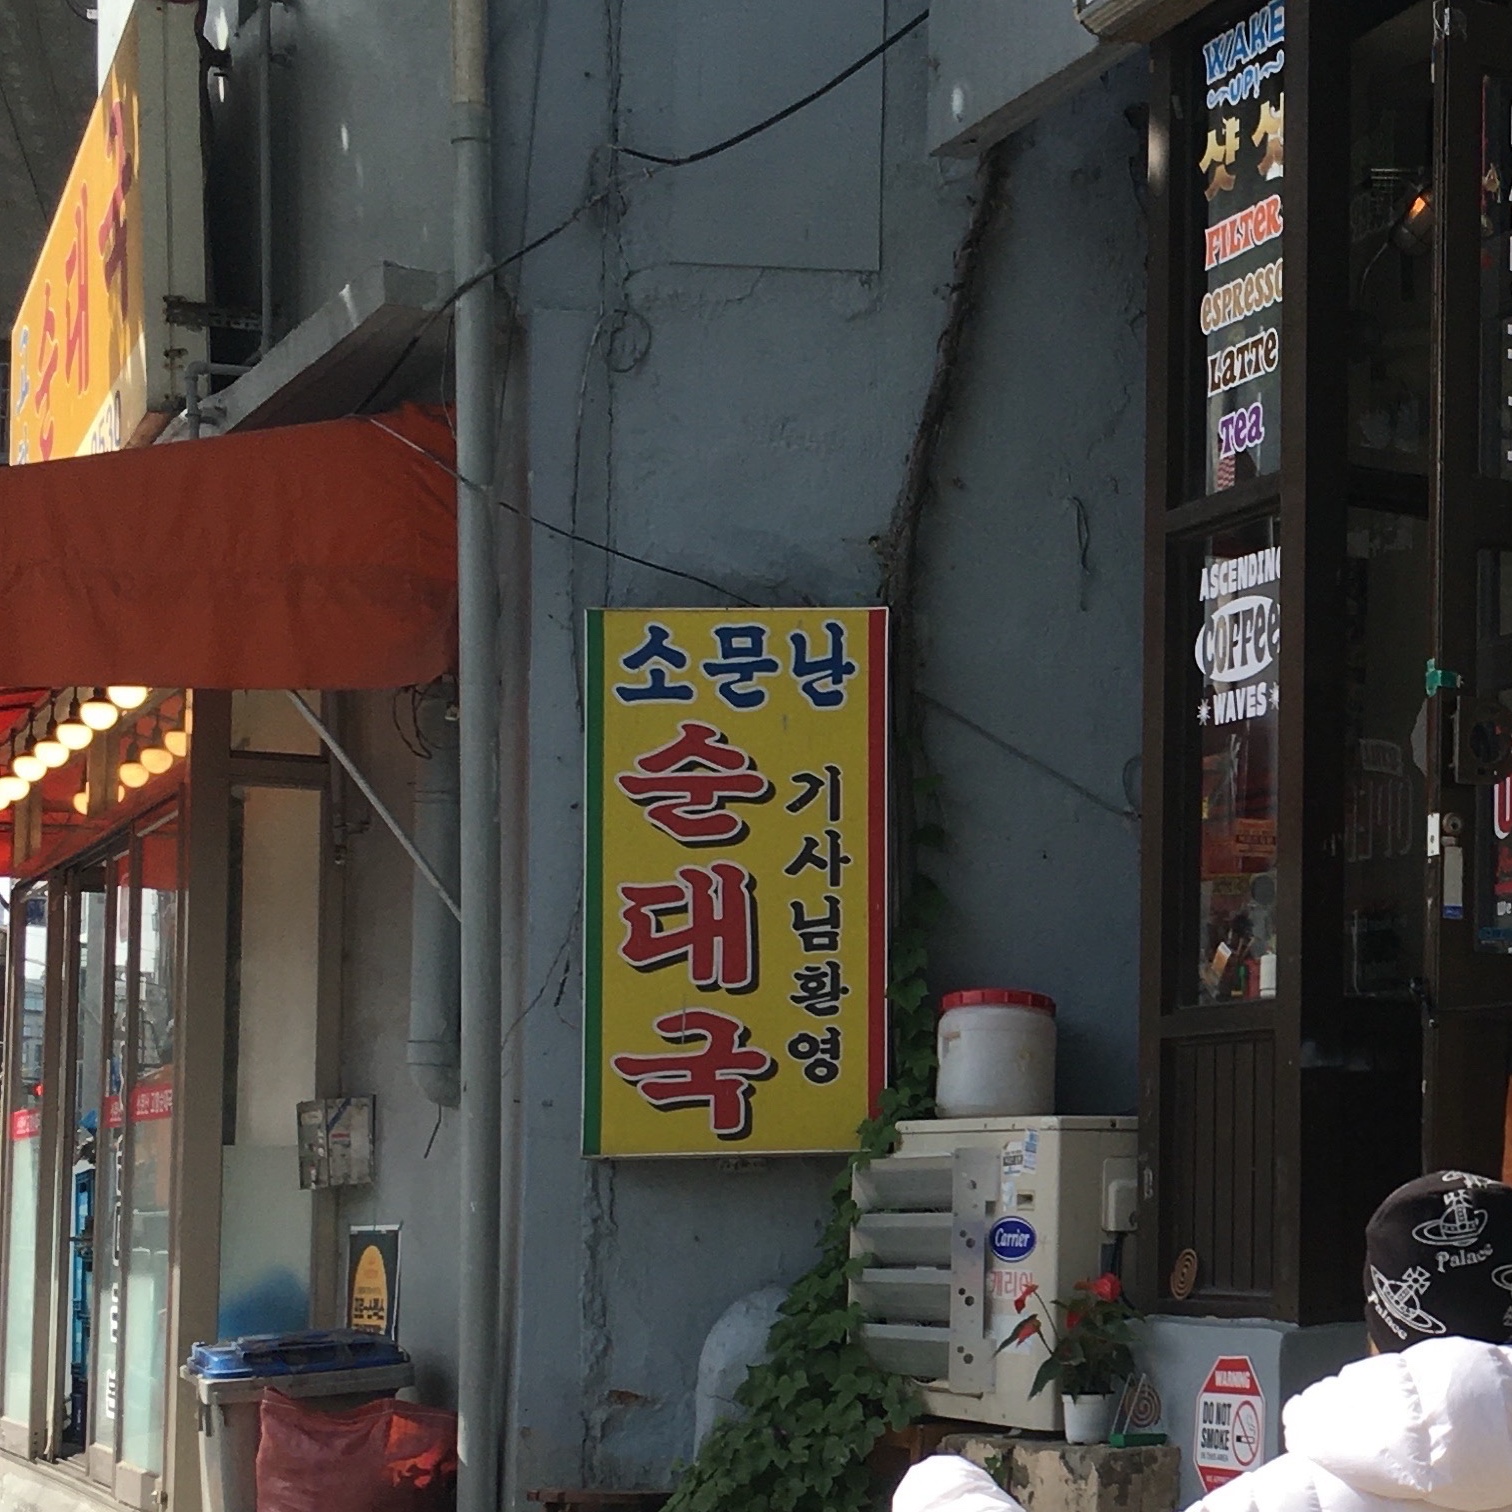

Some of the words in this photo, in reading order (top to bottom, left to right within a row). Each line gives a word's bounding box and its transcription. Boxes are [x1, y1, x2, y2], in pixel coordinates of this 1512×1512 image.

[1203, 0, 1284, 85] WAKE
[613, 621, 859, 710] 소문난
[1213, 682, 1267, 726] WAVES
[1497, 900, 1512, 916] We
[611, 717, 779, 1141] 순대국
[994, 1228, 1030, 1248] Carrier
[1435, 1243, 1493, 1273] Palace
[1215, 1370, 1251, 1389] WARNING
[1202, 1401, 1214, 1424] DO
[1215, 1402, 1232, 1426] NOT
[1201, 1428, 1229, 1450] SMOKE
